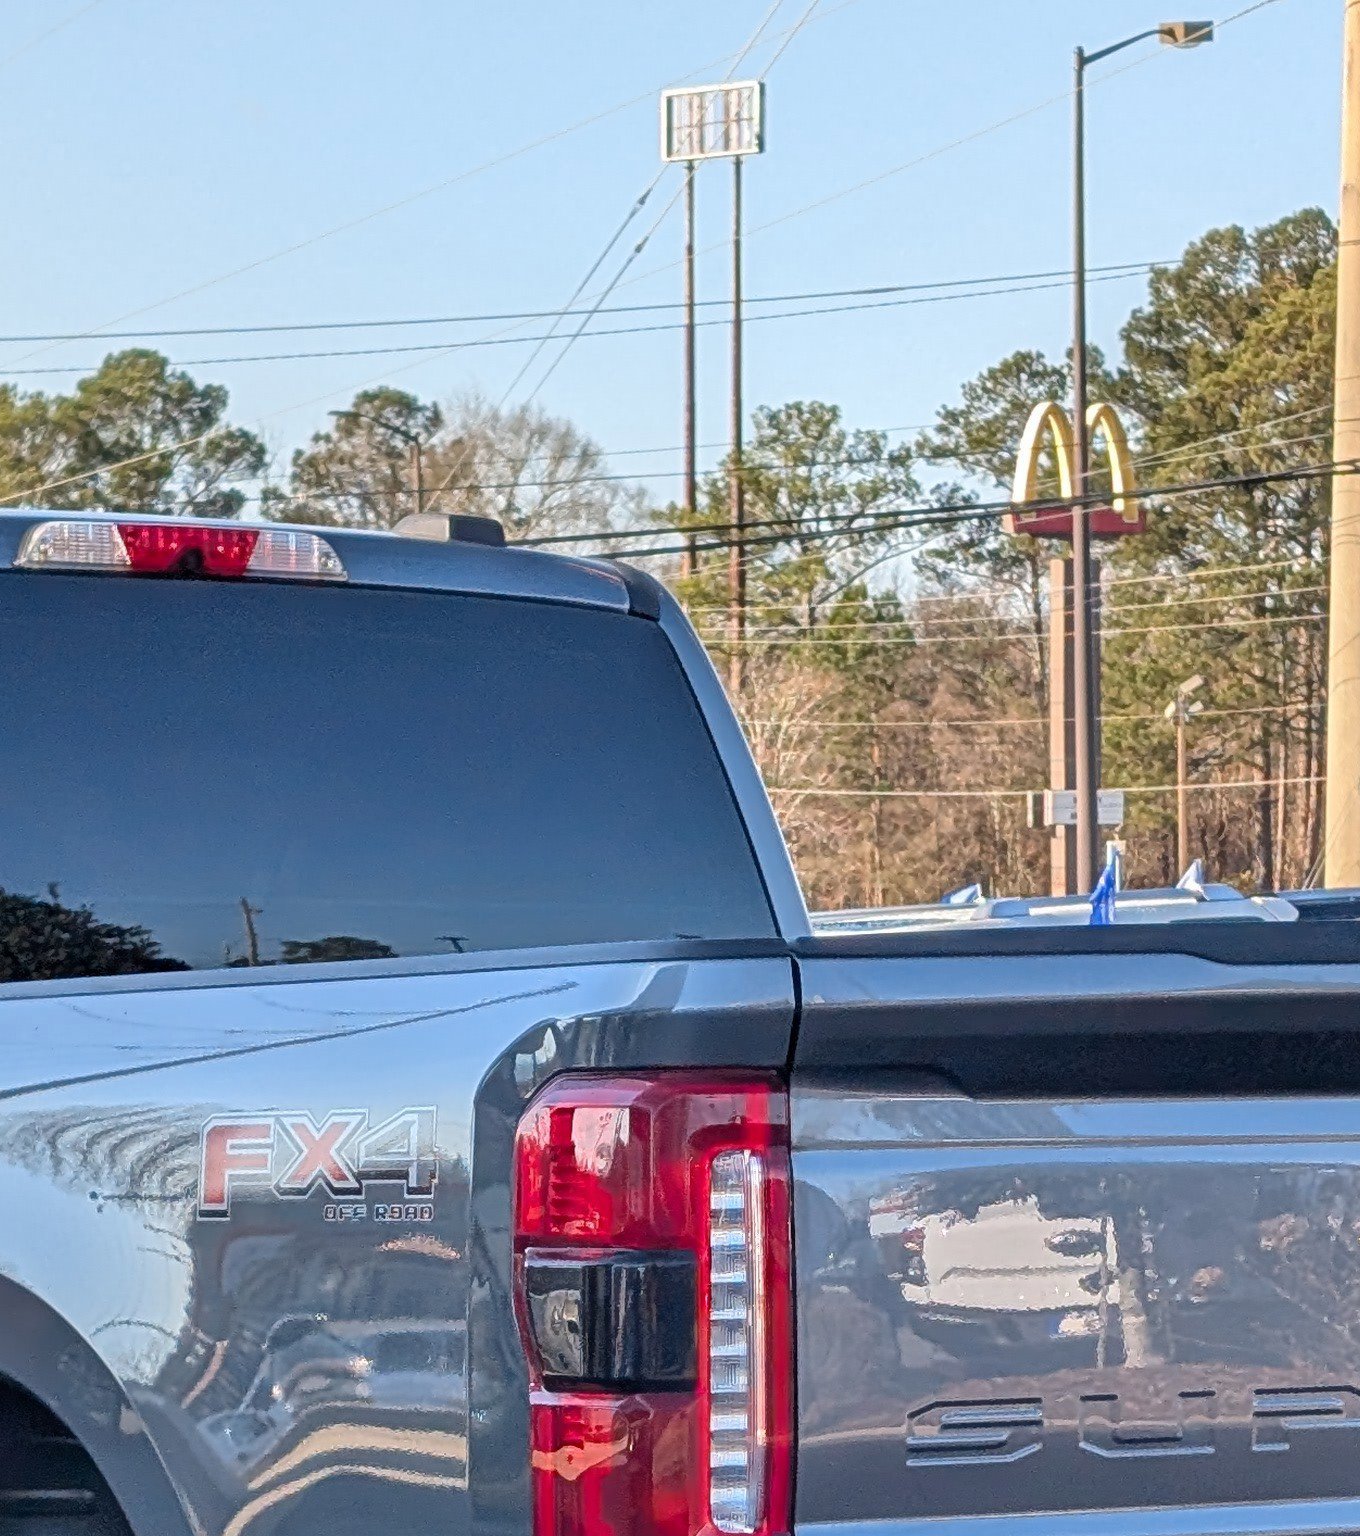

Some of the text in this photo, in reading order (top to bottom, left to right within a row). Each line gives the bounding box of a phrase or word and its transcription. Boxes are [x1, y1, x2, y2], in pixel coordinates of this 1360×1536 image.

[197, 1105, 438, 1220] FX4
[324, 1204, 435, 1221] OFF ROAD
